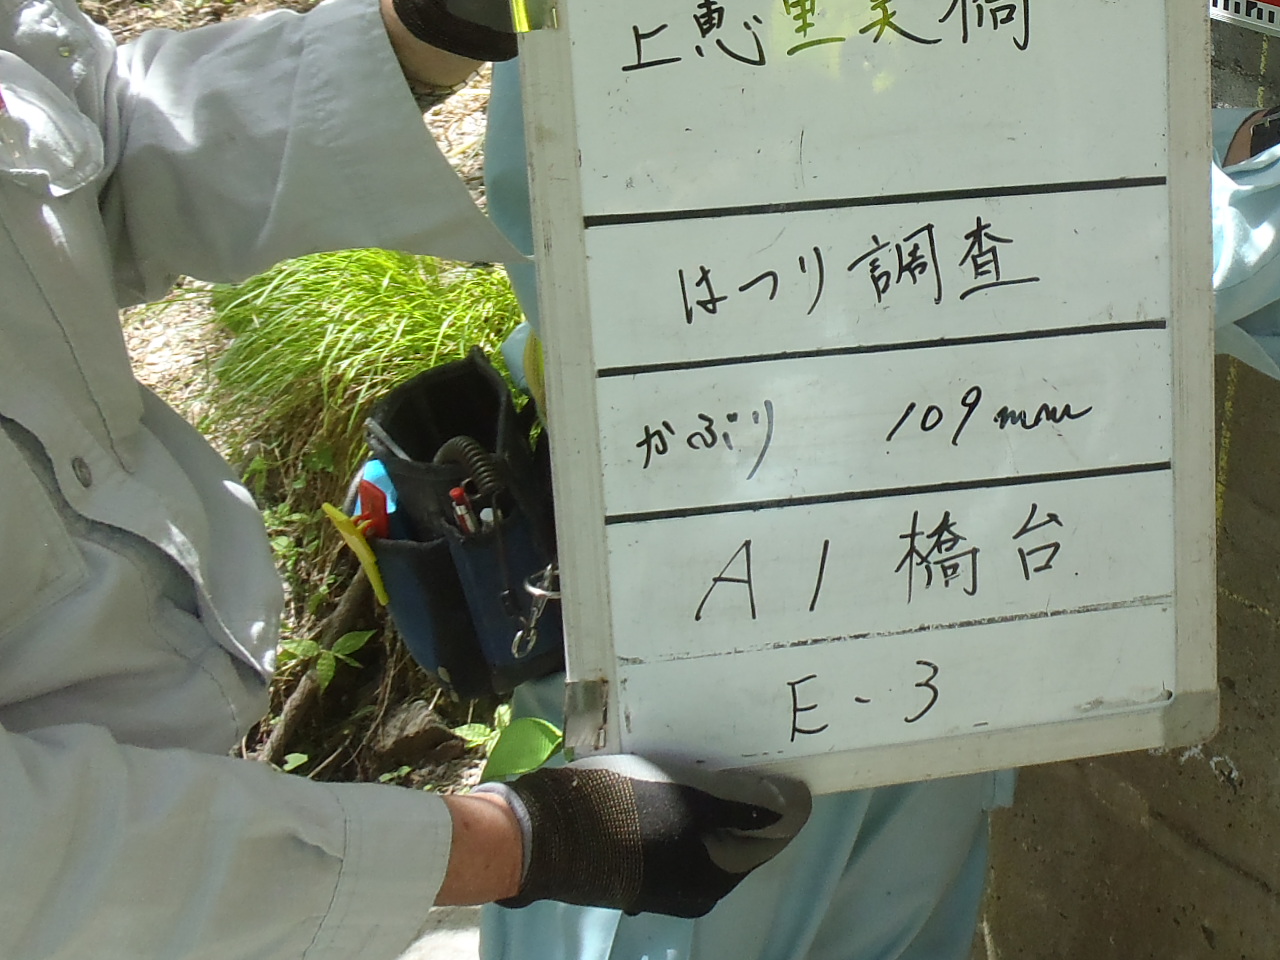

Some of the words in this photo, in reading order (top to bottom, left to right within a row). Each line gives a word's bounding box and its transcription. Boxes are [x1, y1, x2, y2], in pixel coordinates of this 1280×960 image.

[680, 216, 1040, 324] はつり調査
[636, 399, 774, 479] かぶり
